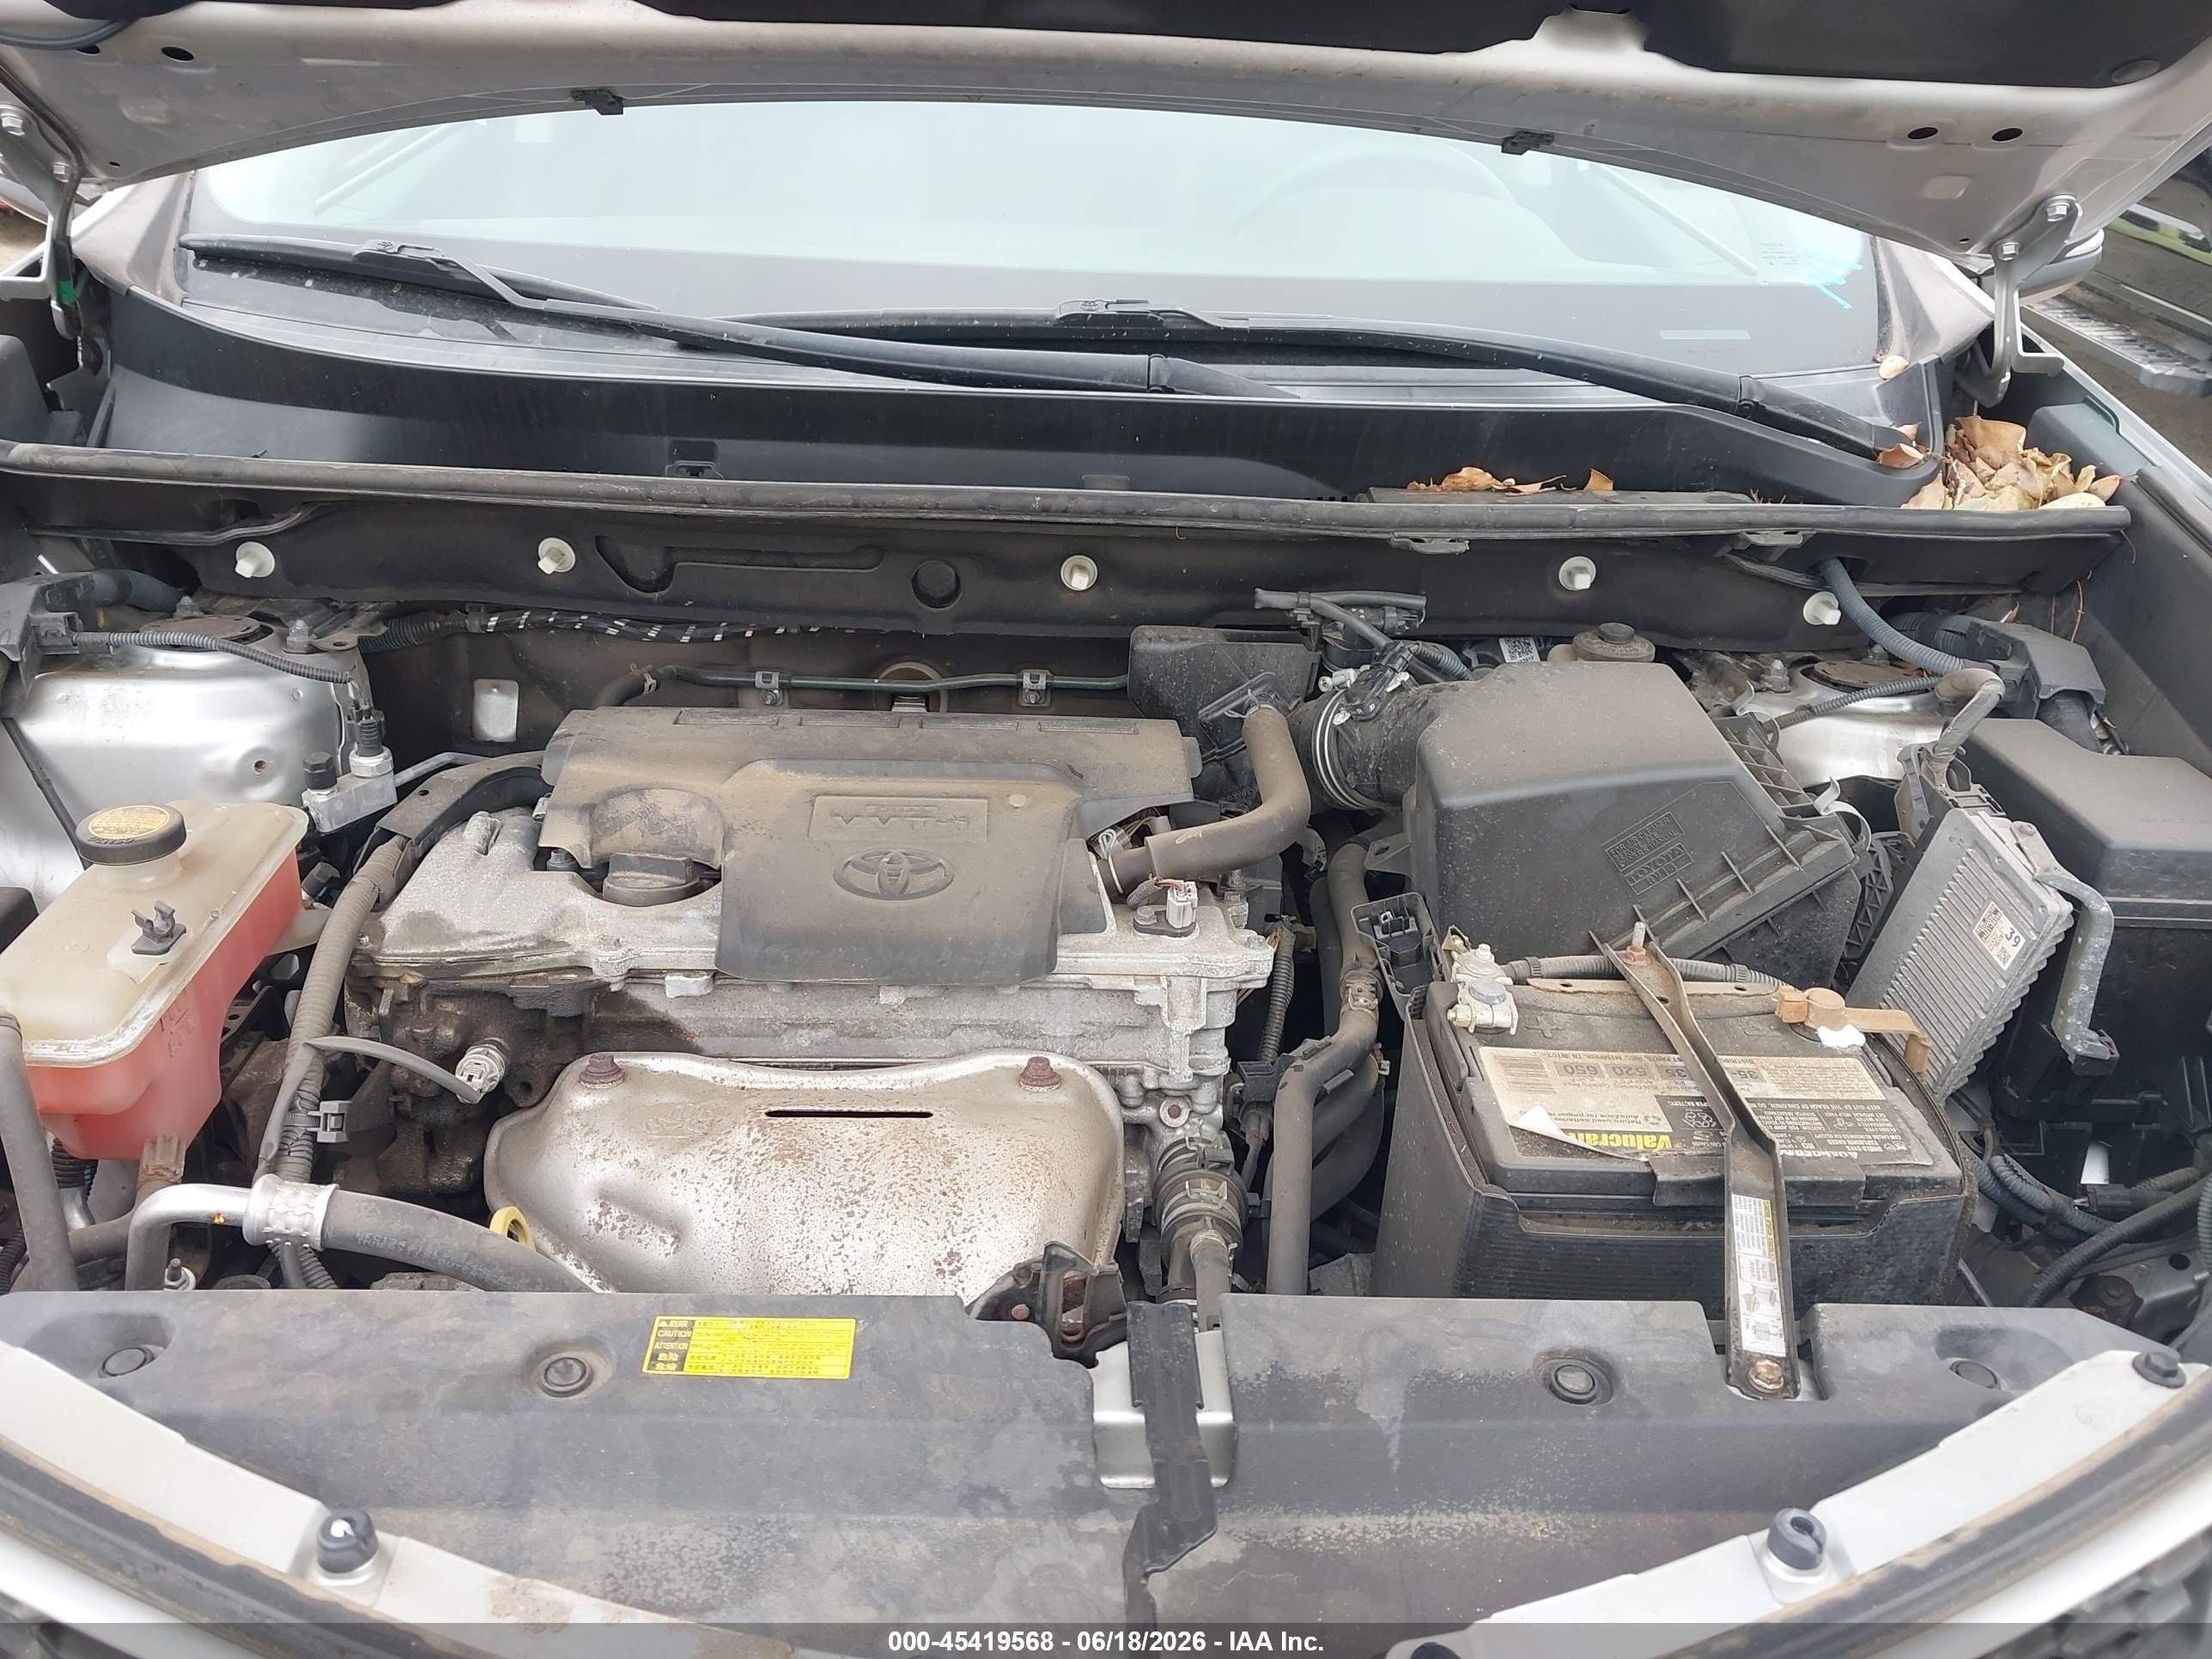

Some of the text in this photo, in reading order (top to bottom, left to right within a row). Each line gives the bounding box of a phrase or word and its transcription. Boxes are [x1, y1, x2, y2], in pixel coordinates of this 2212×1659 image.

[1628, 844, 1686, 884] TOYOTA
[2004, 927, 2021, 947] 39
[1563, 1064, 1598, 1074] 650
[1613, 1065, 1646, 1076] 520
[1665, 1067, 1686, 1078] 35
